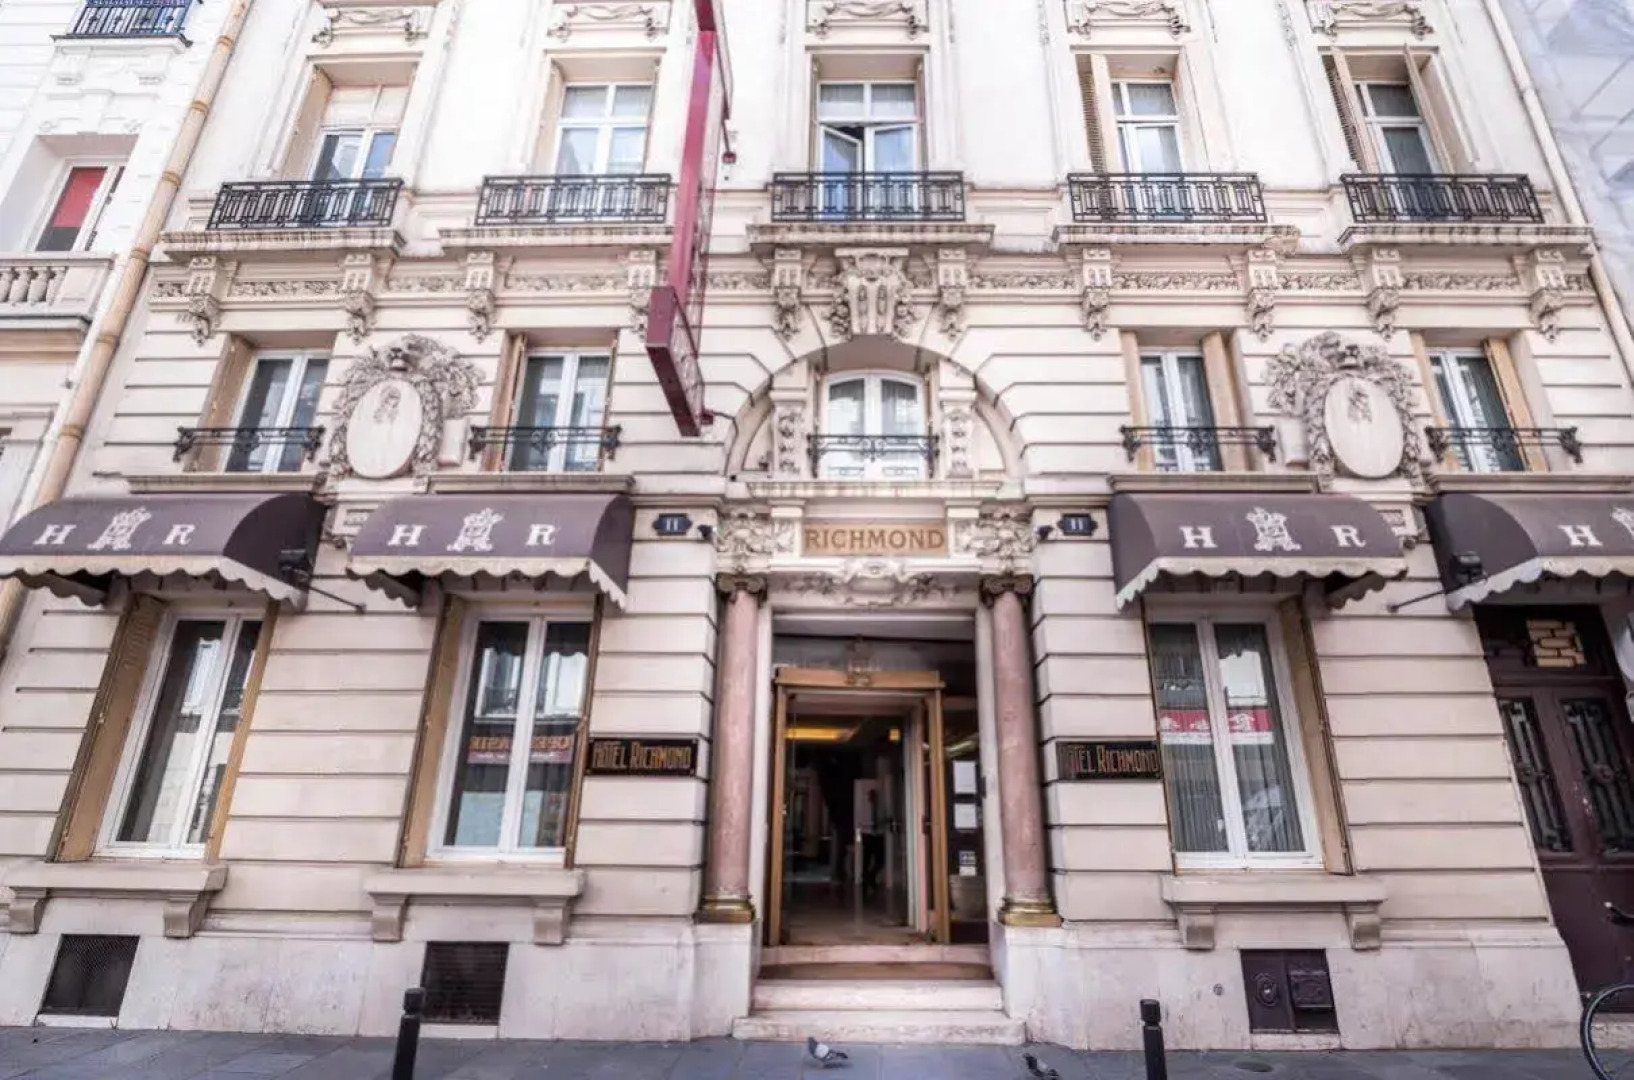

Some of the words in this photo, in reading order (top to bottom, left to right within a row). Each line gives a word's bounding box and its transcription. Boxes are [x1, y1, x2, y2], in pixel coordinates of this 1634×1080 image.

[33, 524, 76, 545] H
[162, 524, 195, 545] R
[387, 524, 426, 546] H
[526, 524, 556, 546] R
[804, 528, 945, 550] RICHMOND
[1179, 526, 1218, 548] H
[1329, 525, 1366, 548] R
[1558, 525, 1603, 546] H
